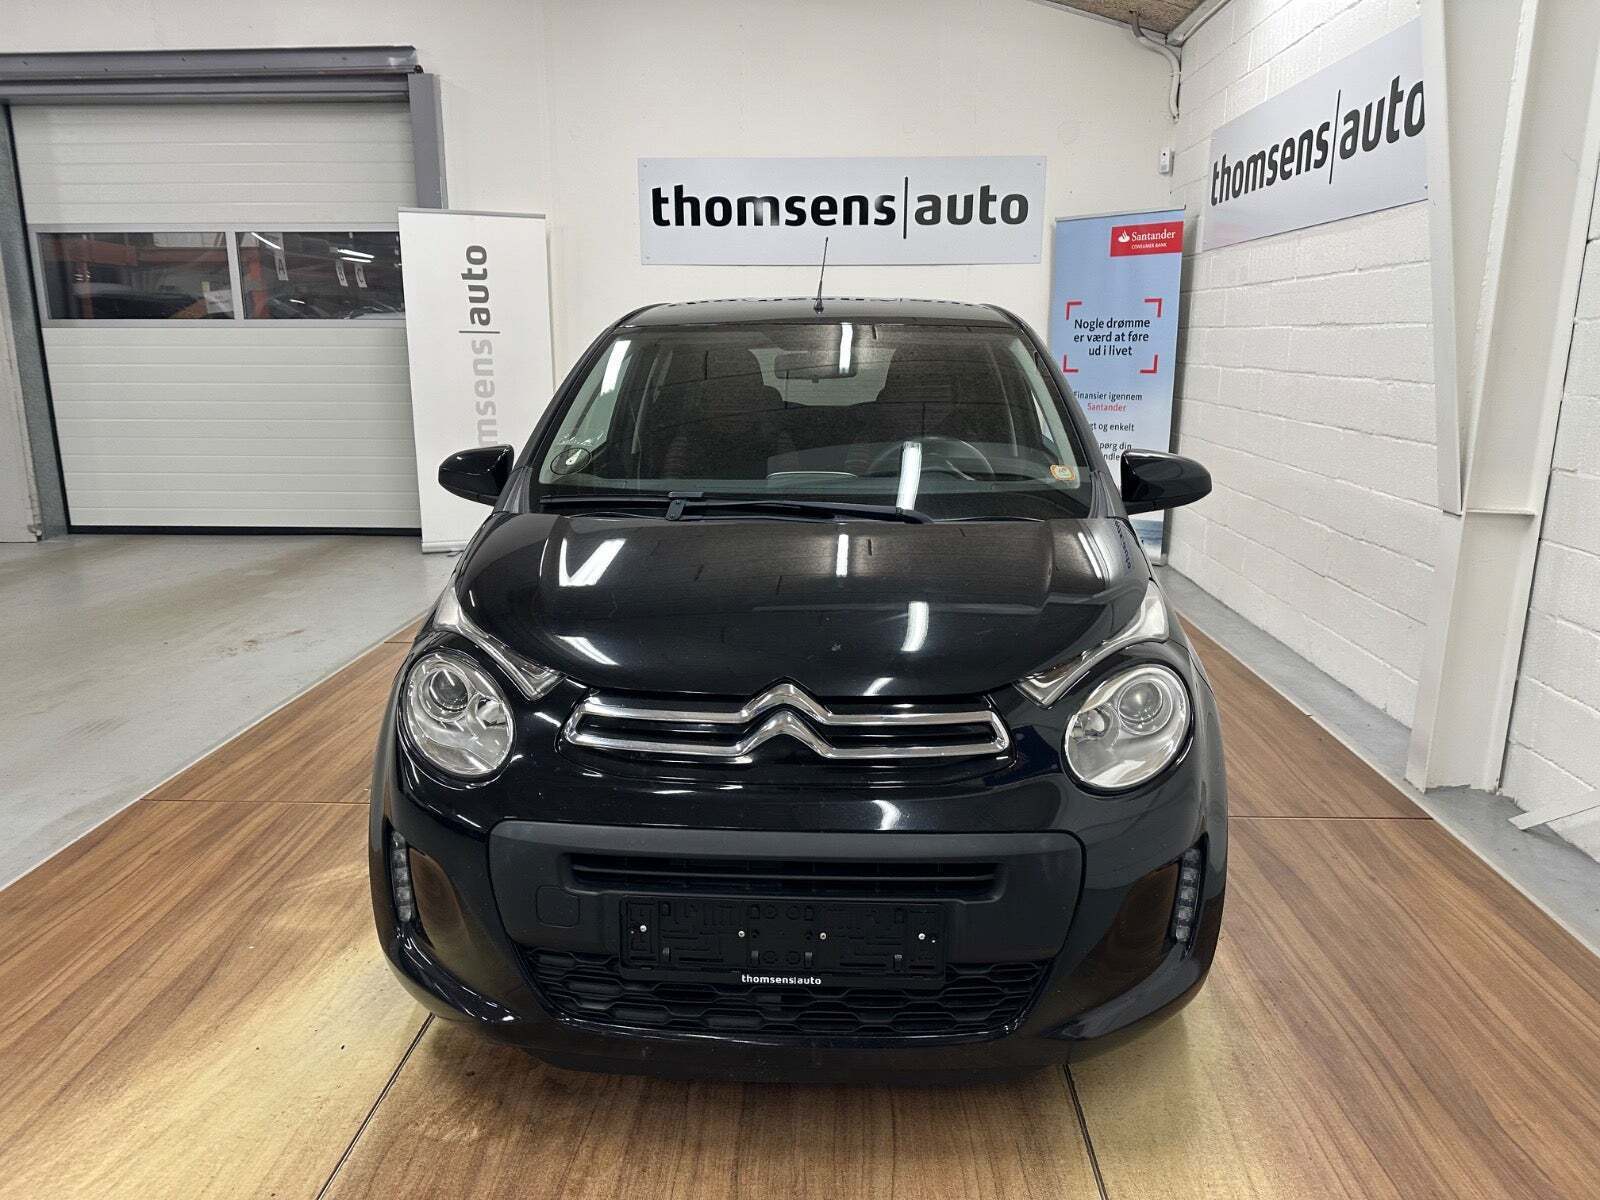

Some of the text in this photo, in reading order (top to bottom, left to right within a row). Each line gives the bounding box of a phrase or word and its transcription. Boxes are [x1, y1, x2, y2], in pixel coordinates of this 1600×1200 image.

[1131, 228, 1176, 241] Santander
[1074, 317, 1150, 331] Nogle drømme
[1074, 331, 1149, 342] er værd at føre
[1088, 345, 1101, 356] ud
[1109, 345, 1132, 356] livet
[1073, 391, 1143, 402] Finansier igennem
[1087, 402, 1126, 411] Santander
[1098, 423, 1108, 432] og
[1109, 422, 1135, 432] enkelt
[1099, 442, 1132, 452] pørg din
